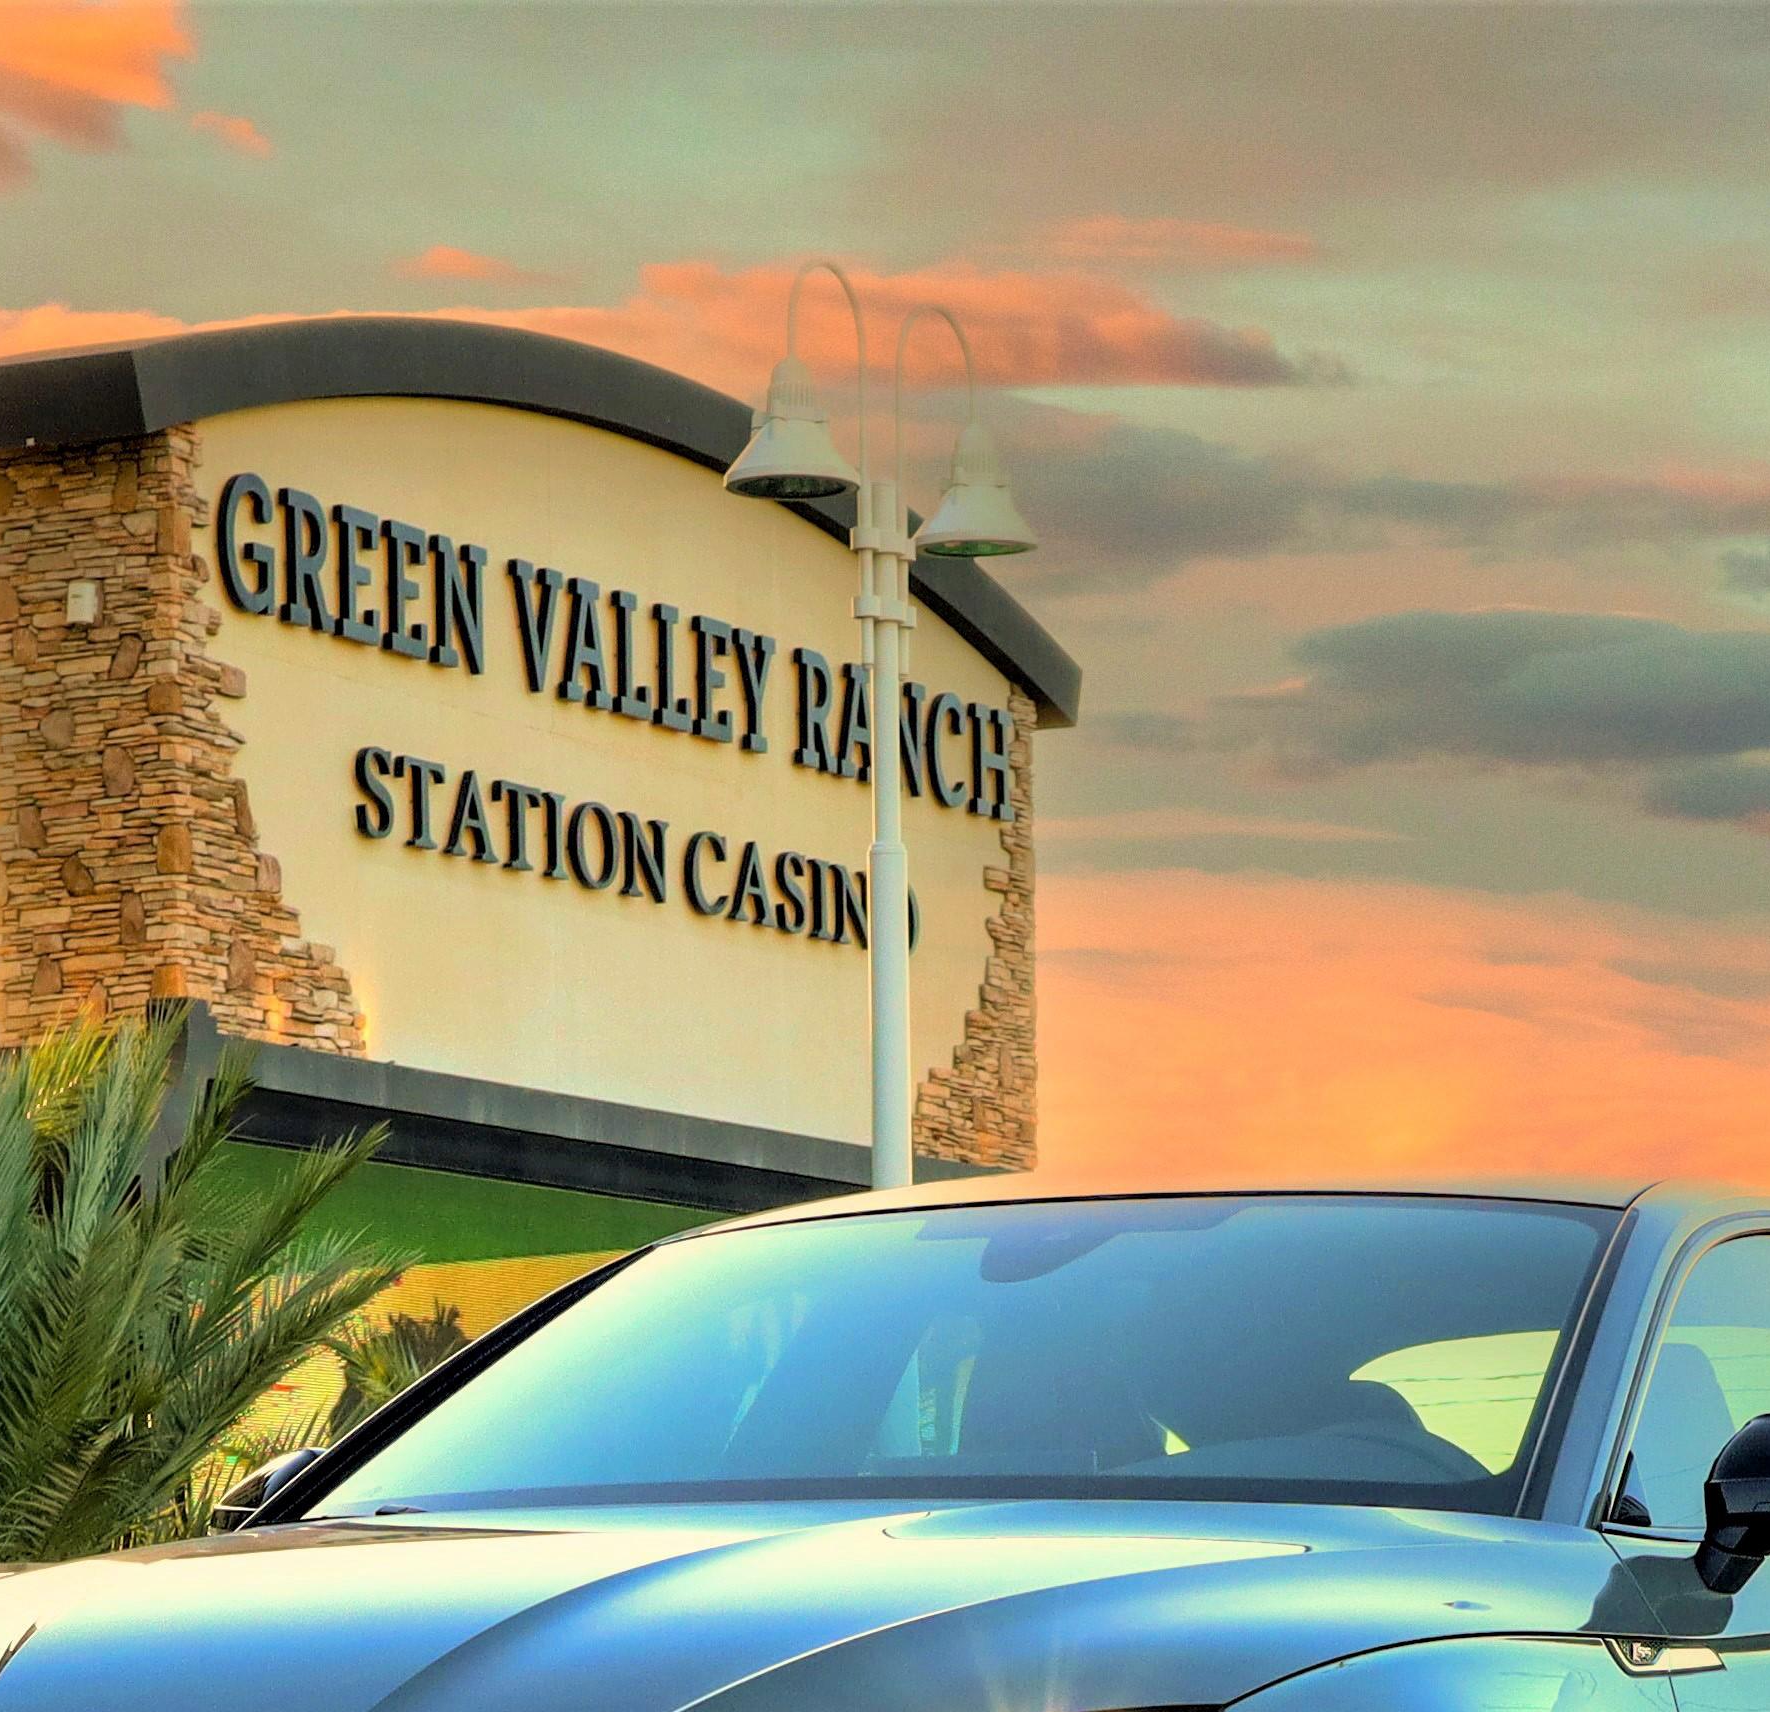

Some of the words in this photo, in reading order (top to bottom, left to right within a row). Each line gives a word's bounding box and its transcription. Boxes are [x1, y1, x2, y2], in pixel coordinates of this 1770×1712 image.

[217, 473, 487, 675] GREEN
[509, 559, 775, 753] VALLEY
[355, 746, 668, 903] STATION
[684, 830, 920, 956] CASIN
